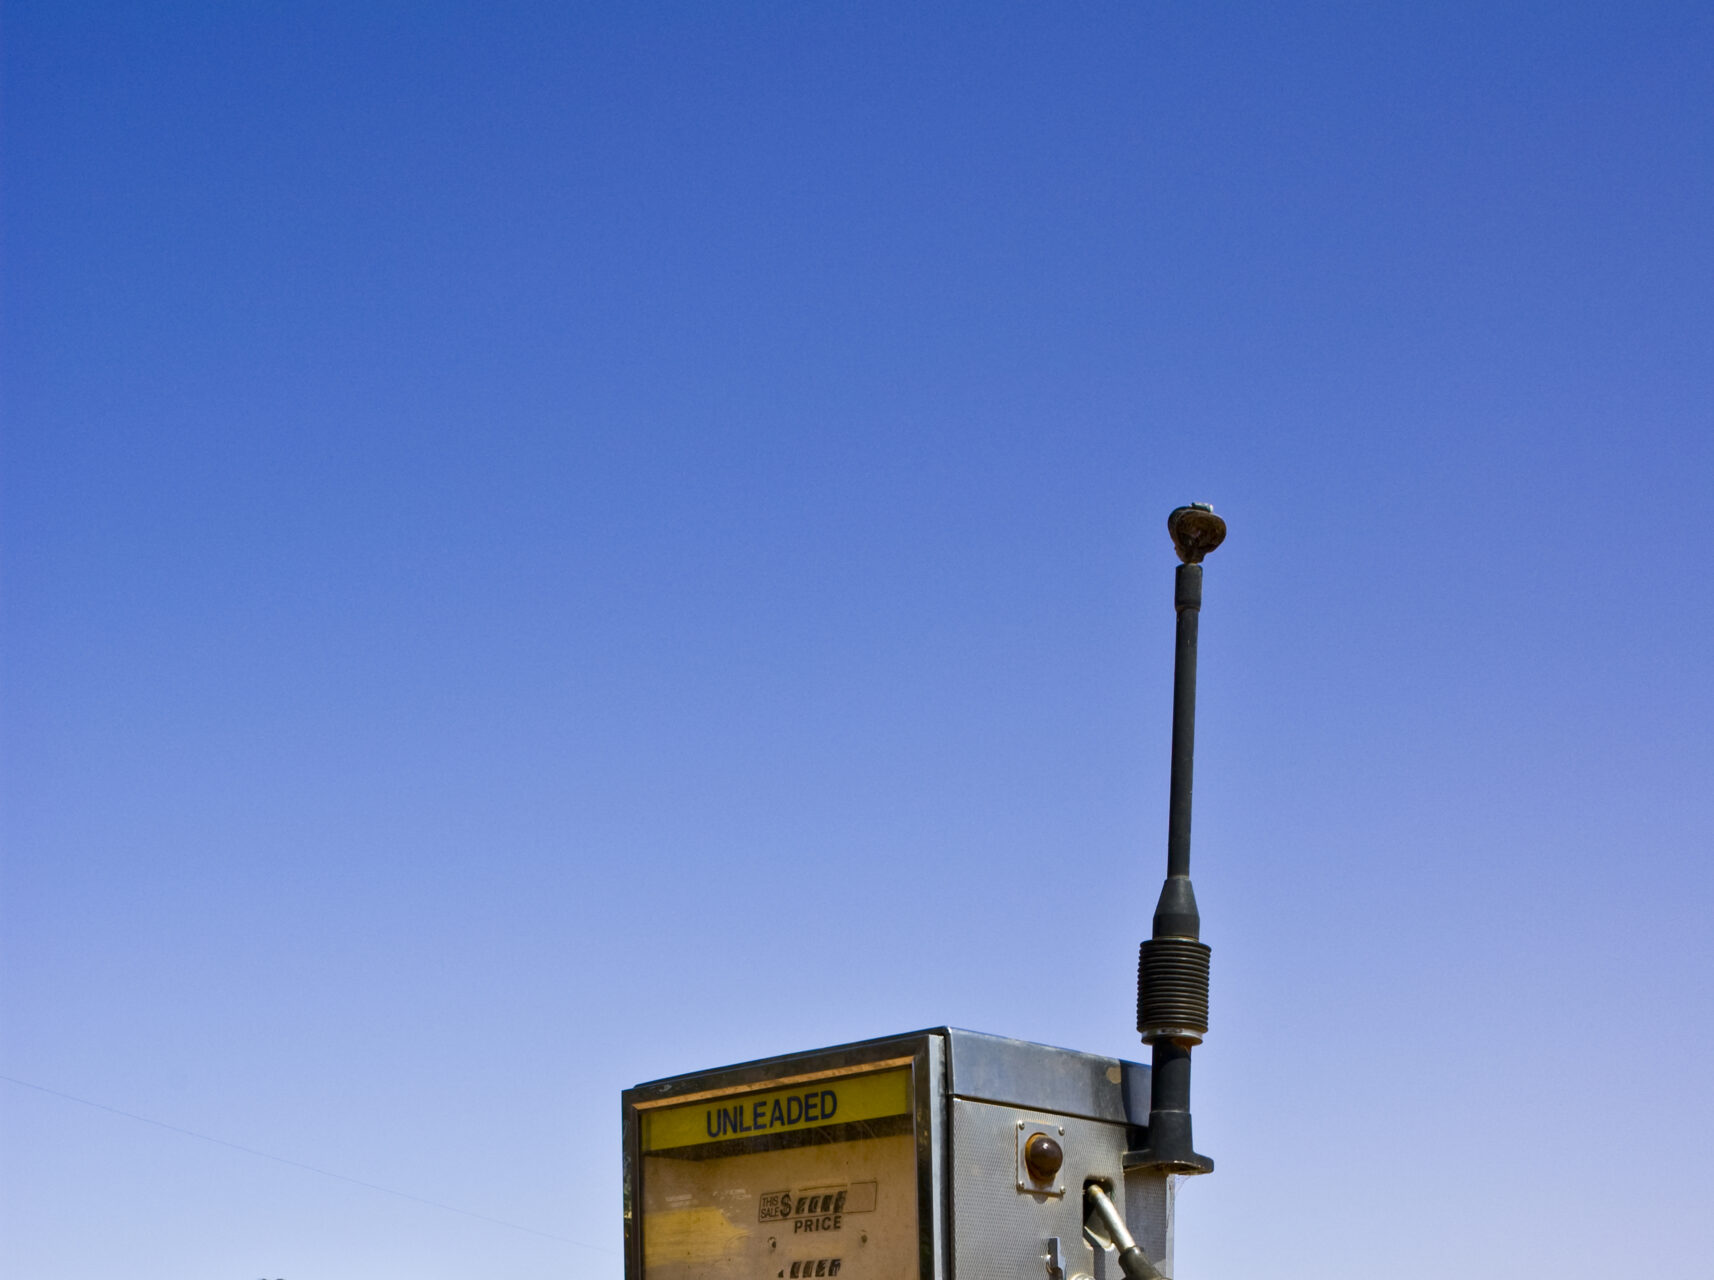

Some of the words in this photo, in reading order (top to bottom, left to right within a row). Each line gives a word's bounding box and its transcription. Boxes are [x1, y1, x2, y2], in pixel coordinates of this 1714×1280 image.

[706, 1090, 838, 1138] UNLEADED
[762, 1195, 779, 1207] THIS
[780, 1193, 792, 1218] $
[760, 1207, 780, 1219] SALE
[794, 1215, 842, 1234] PRICE
